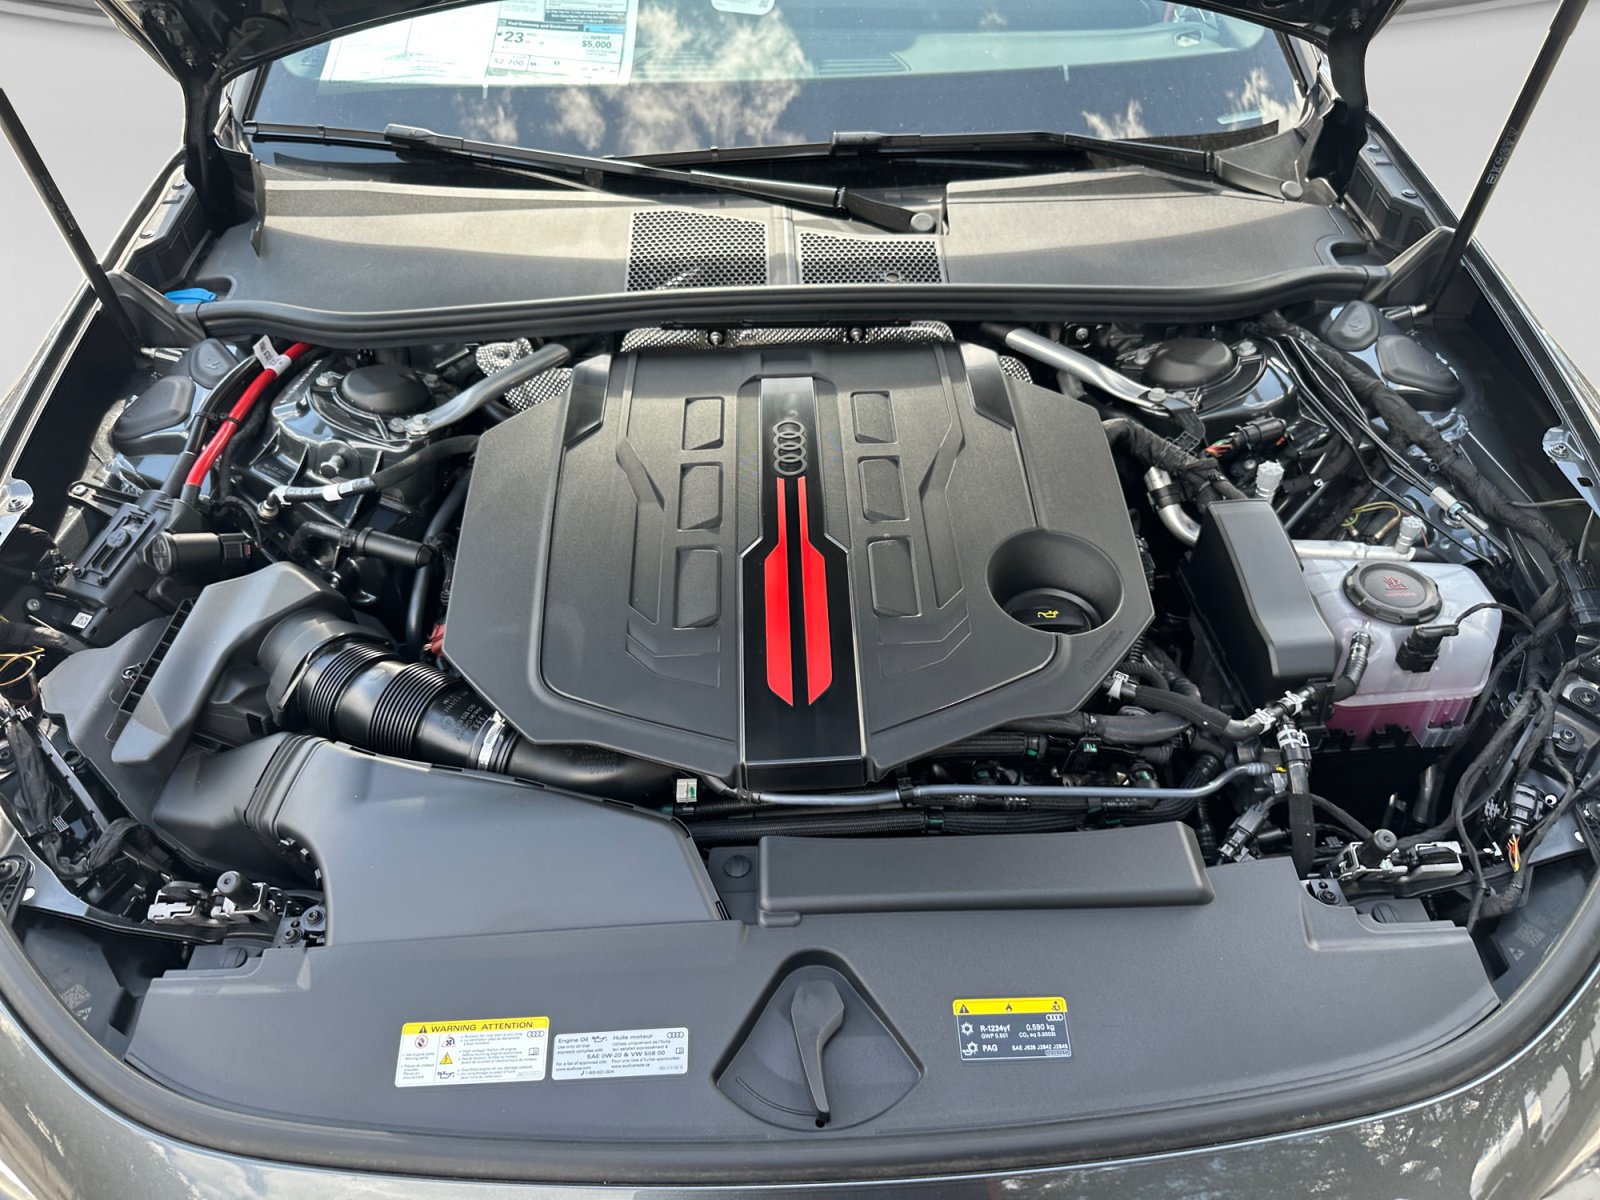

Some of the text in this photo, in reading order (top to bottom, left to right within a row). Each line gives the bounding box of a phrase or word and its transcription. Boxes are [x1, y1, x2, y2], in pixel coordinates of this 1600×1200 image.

[503, 31, 525, 43] 23
[581, 40, 611, 49] $5,000
[431, 1021, 534, 1033] WARNING ATTENTION
[980, 1023, 1055, 1032] R-1234yf 0.590 kg
[982, 1044, 998, 1052] PAG
